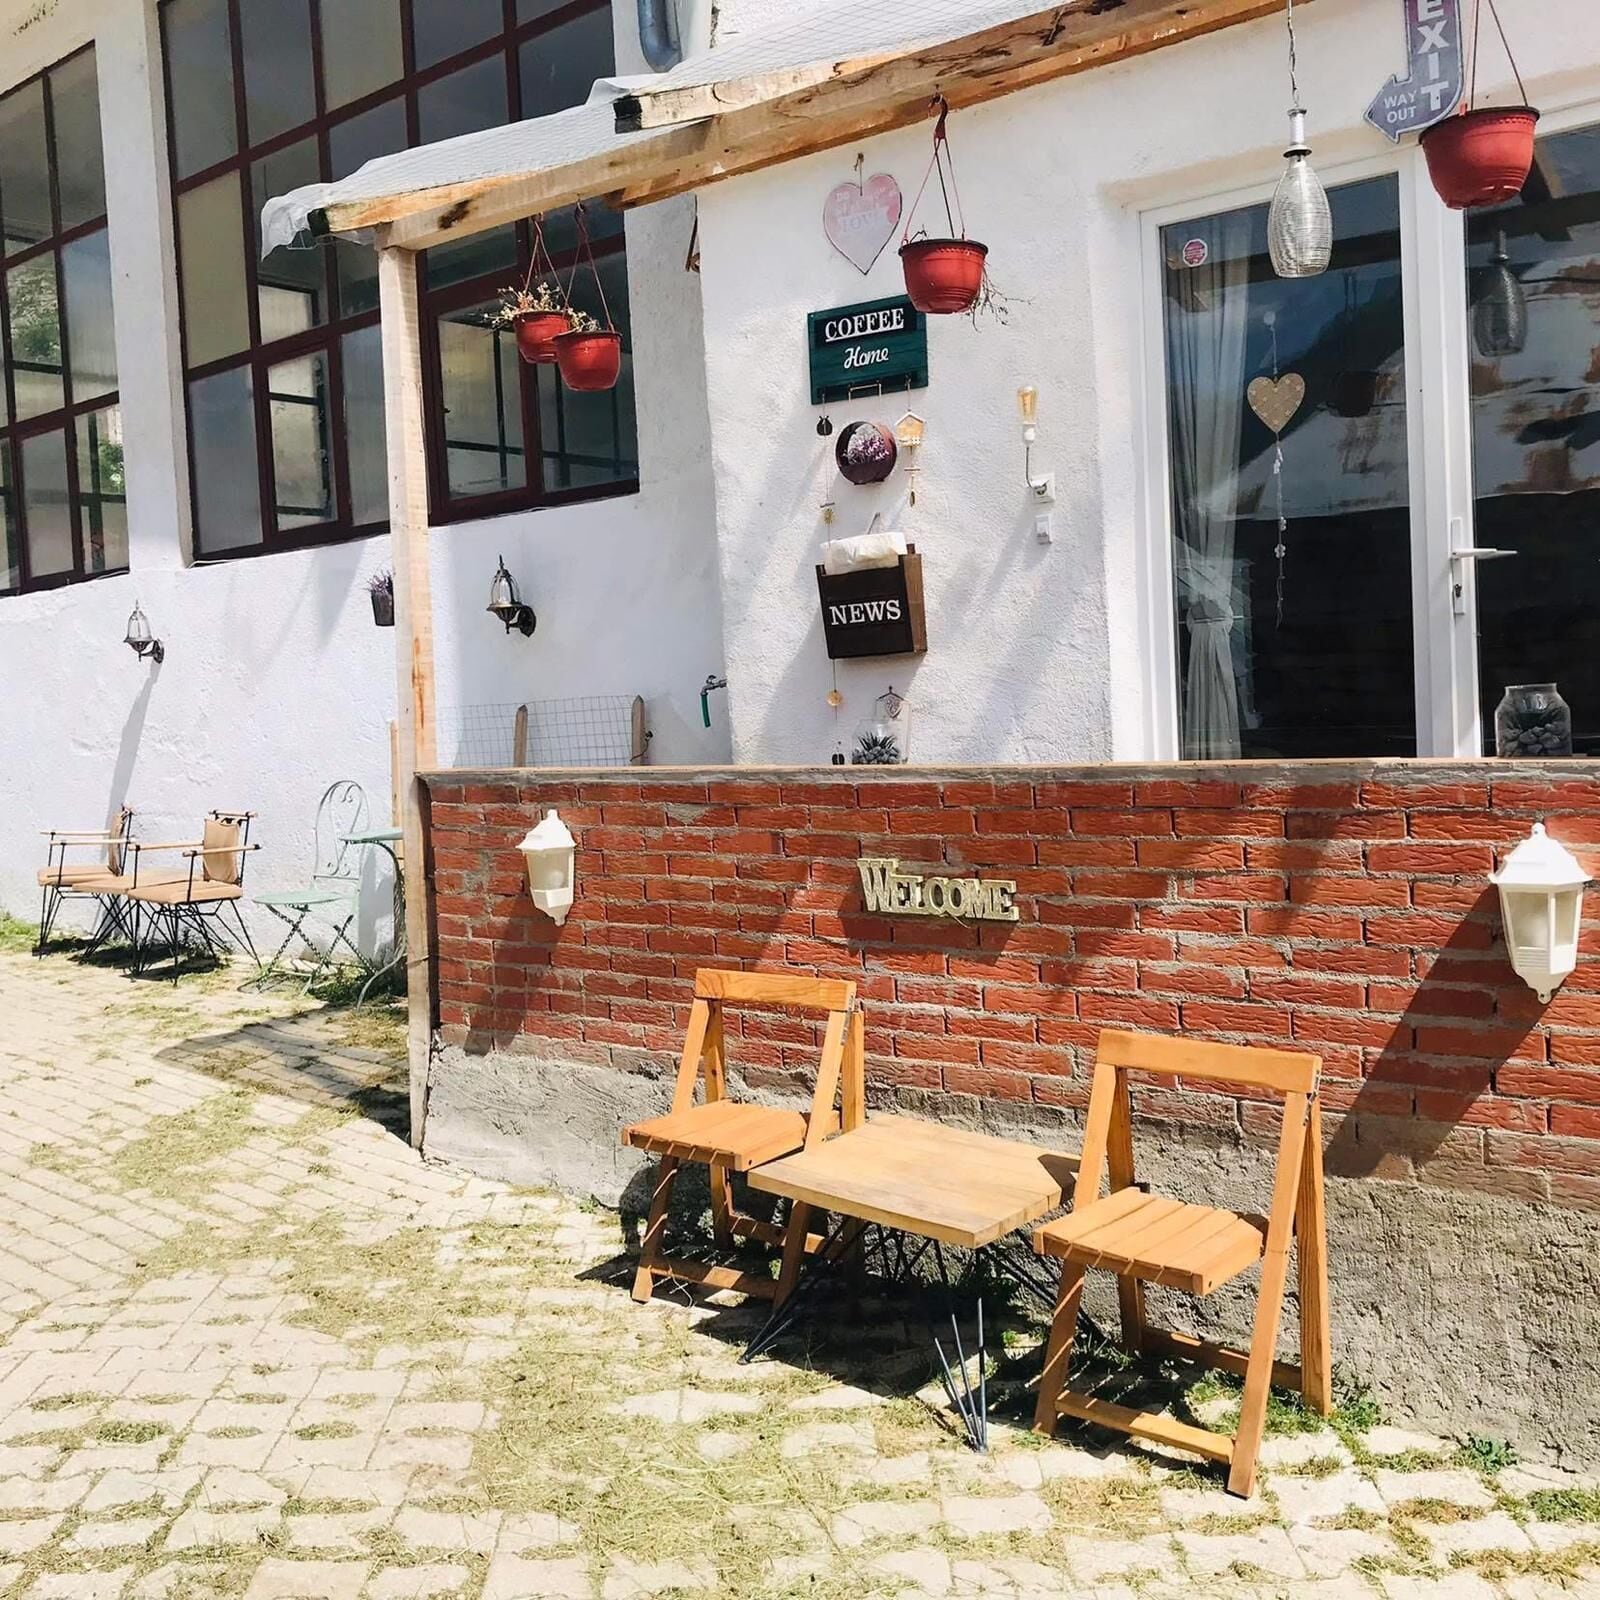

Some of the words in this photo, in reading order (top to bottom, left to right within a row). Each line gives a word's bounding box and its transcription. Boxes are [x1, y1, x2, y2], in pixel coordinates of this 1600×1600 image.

[1417, 0, 1449, 111] EXIT
[1383, 89, 1417, 109] WAY
[1386, 105, 1417, 124] OUT
[824, 308, 904, 340] COFFEE
[843, 346, 889, 369] Home
[828, 599, 901, 626] NEWS
[857, 857, 1020, 922] WELCOME
